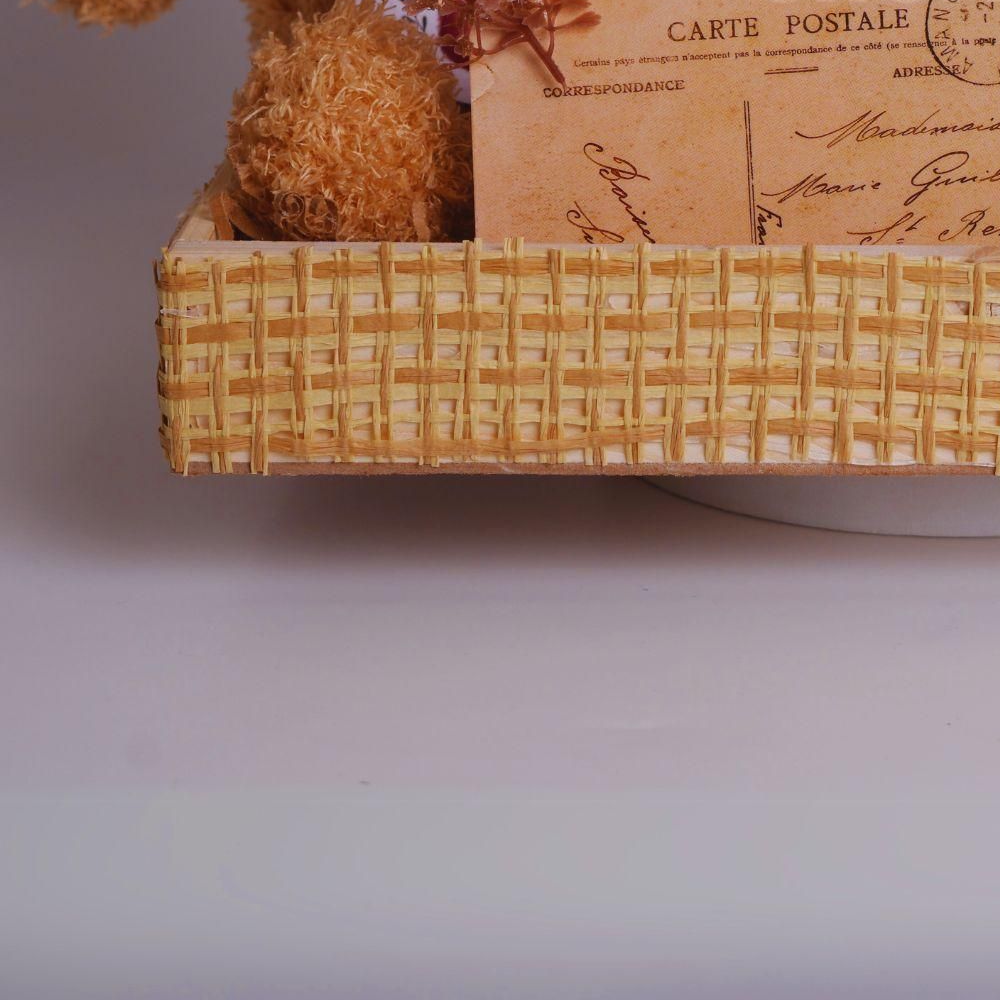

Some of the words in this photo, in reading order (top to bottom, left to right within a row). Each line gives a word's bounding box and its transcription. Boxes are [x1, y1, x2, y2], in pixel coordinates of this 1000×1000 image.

[667, 17, 760, 42] CARTE
[785, 7, 911, 36] POSTALE
[734, 49, 750, 60] pas
[764, 45, 833, 60] correspondance
[836, 43, 847, 53] de
[850, 44, 861, 52] ce
[892, 64, 961, 79] ADRESSE
[543, 79, 686, 98] CORRESPONDANCE
